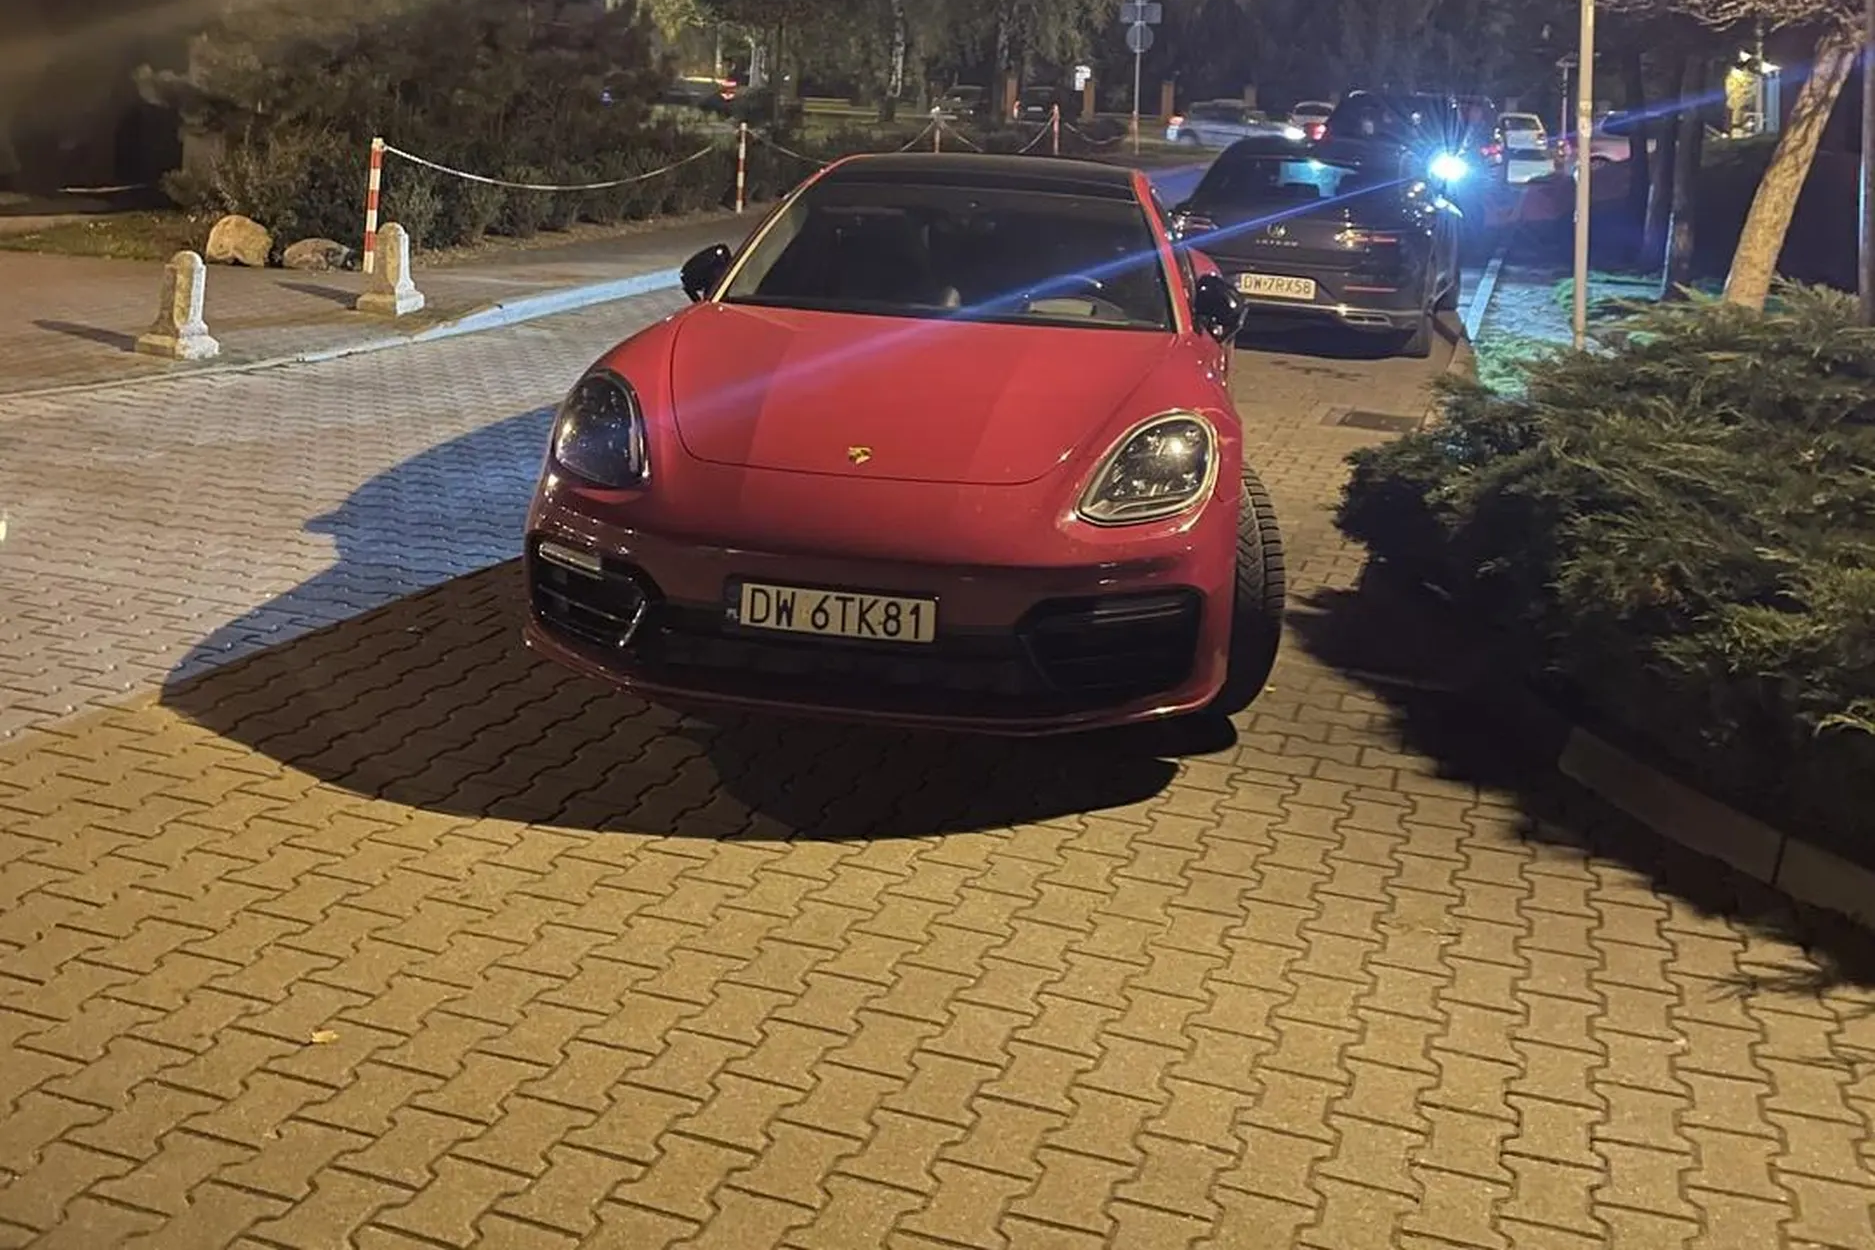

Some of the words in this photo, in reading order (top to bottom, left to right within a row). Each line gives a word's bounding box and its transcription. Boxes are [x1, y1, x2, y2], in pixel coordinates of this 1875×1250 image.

[1243, 275, 1262, 290] DW
[749, 587, 796, 627] DW
[810, 595, 921, 640] 6TK81
